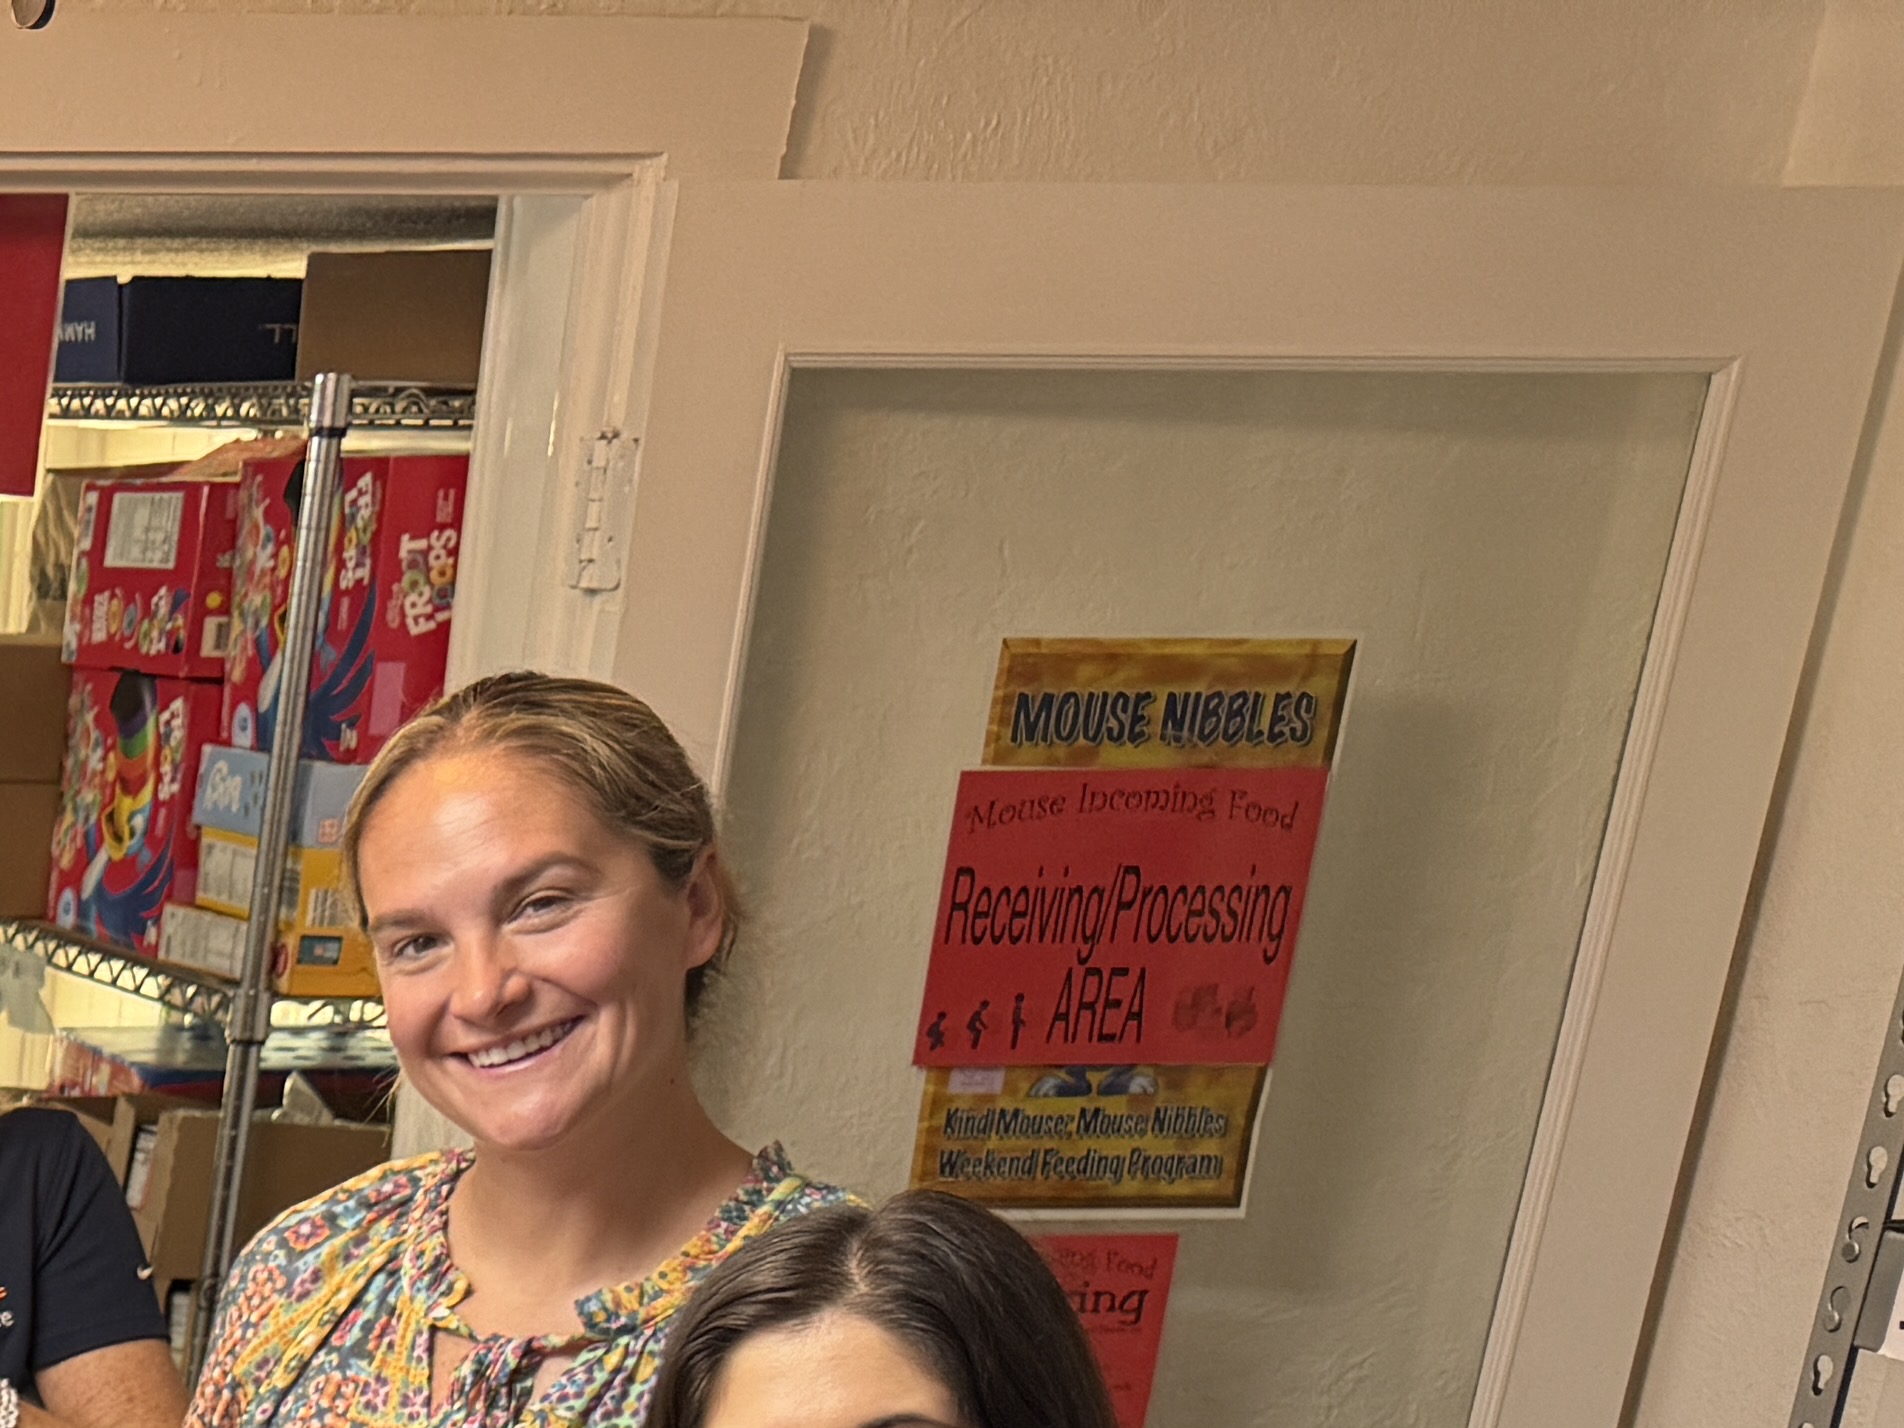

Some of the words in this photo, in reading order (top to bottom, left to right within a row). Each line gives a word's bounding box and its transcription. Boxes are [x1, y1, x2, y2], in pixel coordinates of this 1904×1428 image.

[1009, 691, 1154, 746] MOUSE
[1158, 691, 1316, 747] NIBBLES
[1077, 782, 1218, 821] Incoming
[1228, 789, 1300, 832] Food
[944, 862, 1293, 966] Receiving/Processing
[1045, 966, 1147, 1043] AREA
[1151, 1105, 1227, 1139] Nibbles
[938, 1150, 1038, 1182] Weekend
[1039, 1147, 1126, 1184] Feeding
[1126, 1147, 1224, 1185] Program
